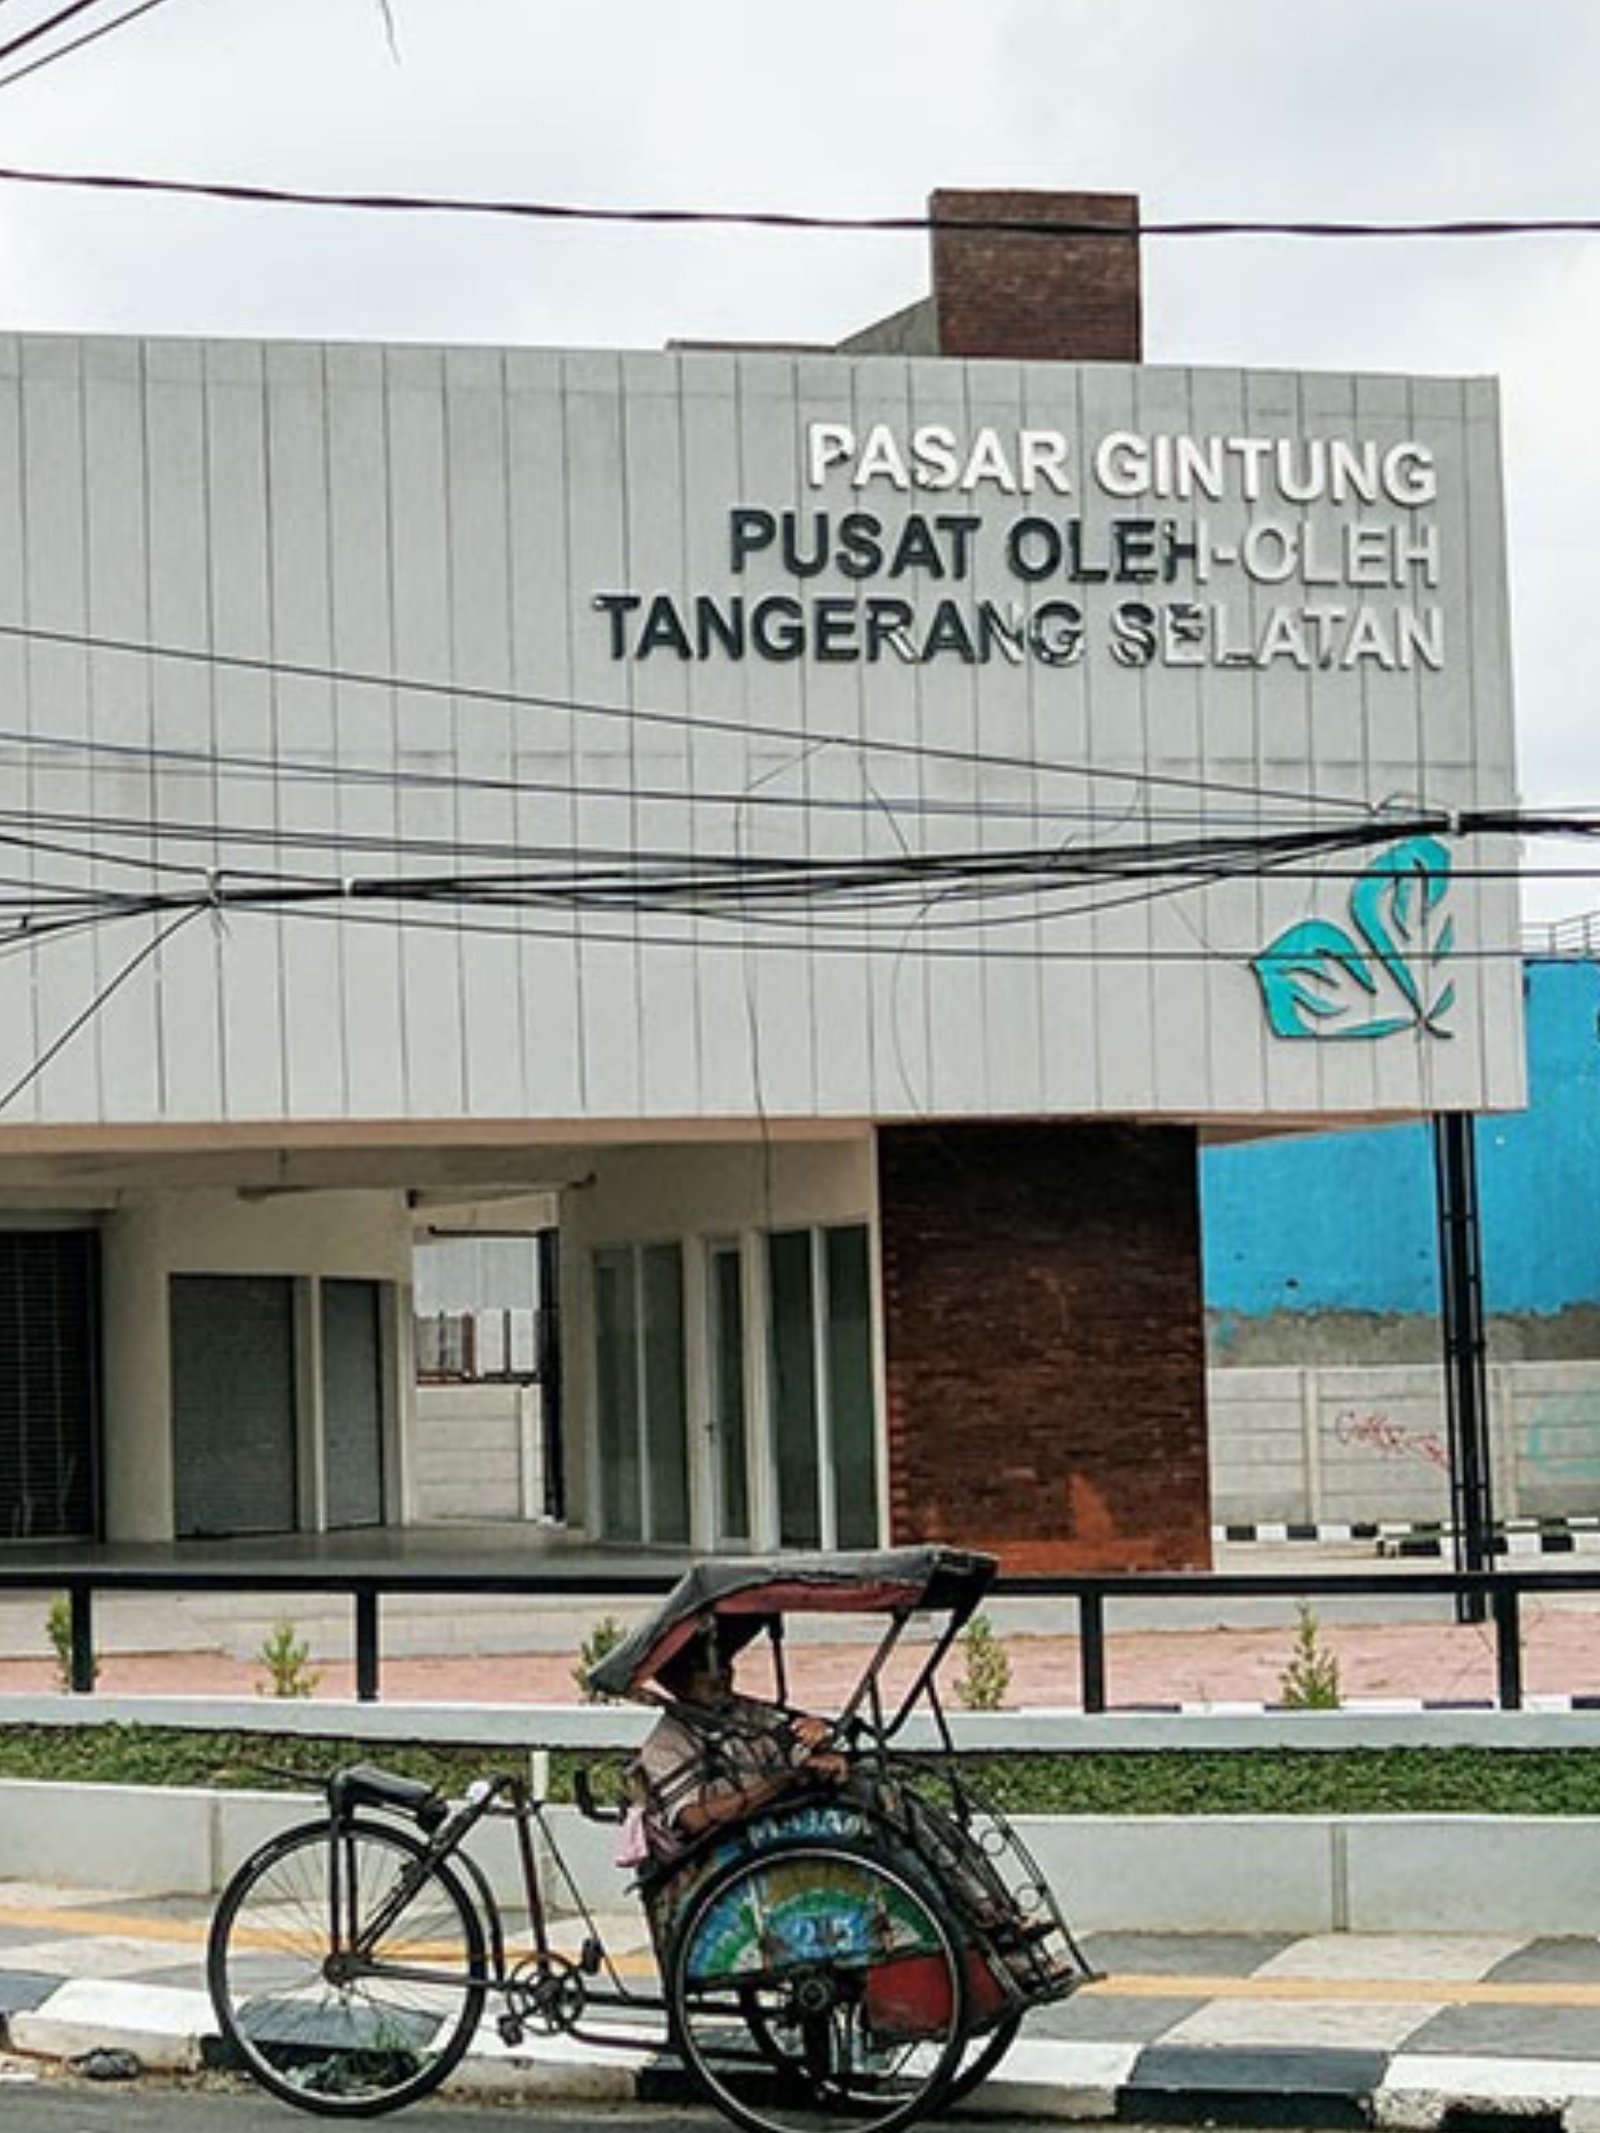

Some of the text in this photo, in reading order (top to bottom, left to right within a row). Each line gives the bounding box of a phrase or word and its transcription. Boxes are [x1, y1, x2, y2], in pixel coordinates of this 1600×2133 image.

[806, 421, 1438, 506] PASAR GINTUNG
[729, 507, 1441, 587] PUSAT OLEH-OLEH
[593, 592, 1445, 671] TANGERANG SELATAN
